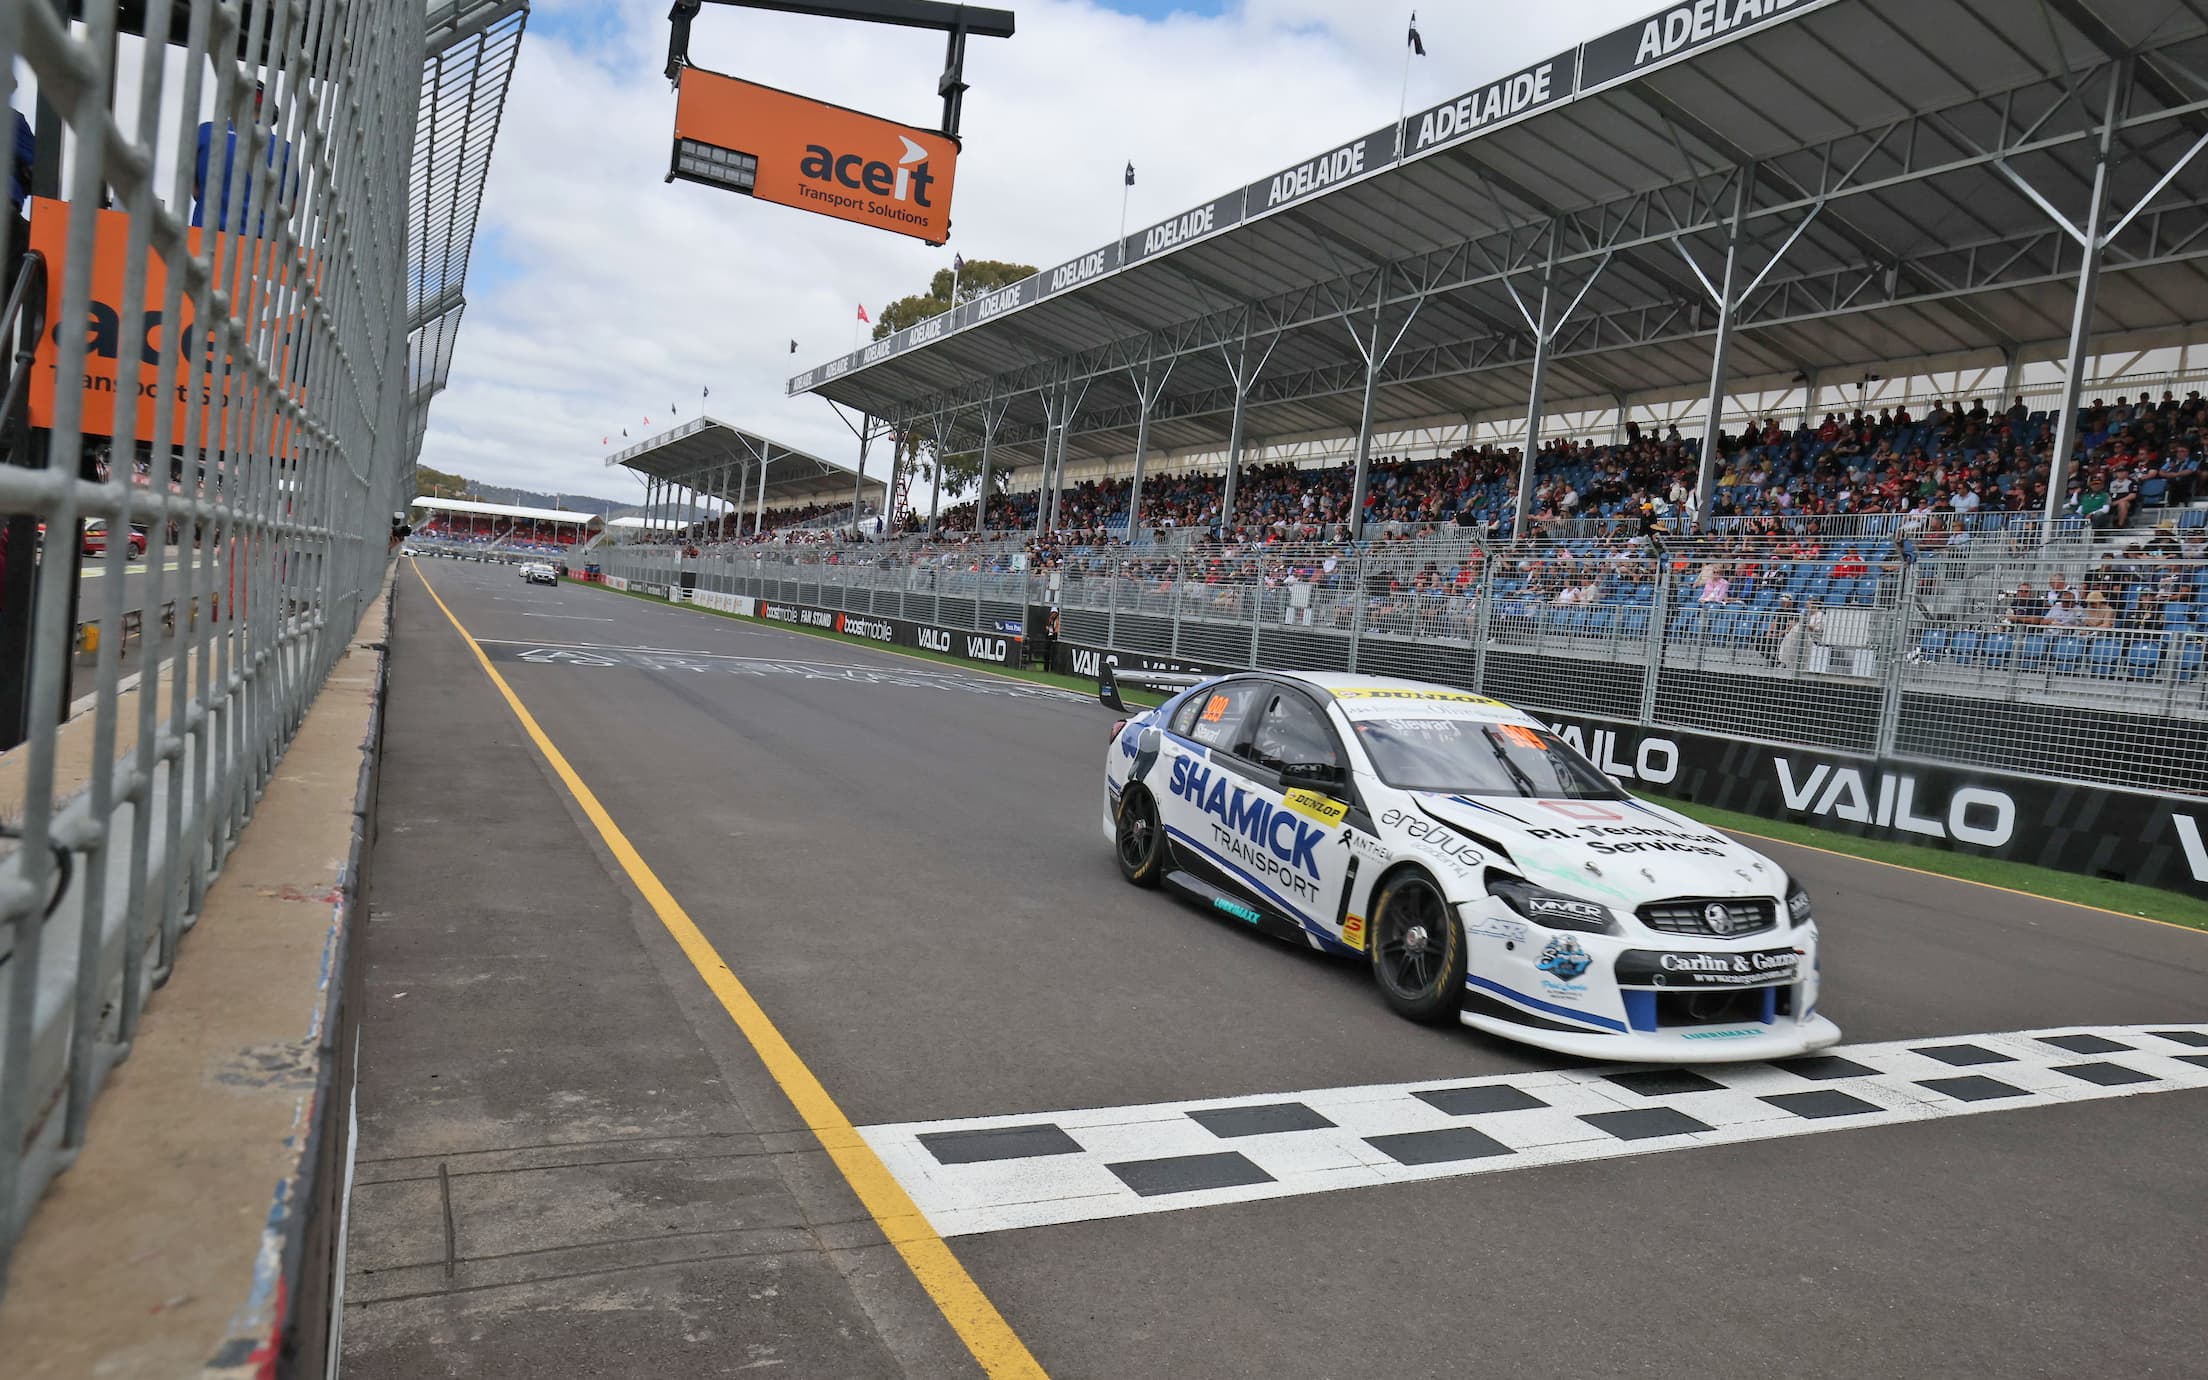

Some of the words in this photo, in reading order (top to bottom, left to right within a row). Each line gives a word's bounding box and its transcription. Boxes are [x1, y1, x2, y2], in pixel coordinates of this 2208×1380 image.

[1634, 0, 1796, 65] ADELA
[1416, 62, 1553, 149] ADELAIDE
[799, 135, 935, 207] aceit
[1268, 140, 1366, 206] ADELAIDE
[798, 183, 864, 210] Transport
[867, 201, 929, 227] Solutions
[1144, 204, 1215, 255] ADELAIDE
[1051, 250, 1104, 292] ADELAIDE
[978, 285, 1021, 320] ADELAIDE
[909, 318, 942, 347] ADELAIDE
[863, 340, 891, 364] ADELAIDE
[825, 357, 849, 379] ADELAIDE
[800, 609, 812, 624] FAN
[812, 611, 832, 627] STAND
[844, 613, 893, 642] boostmobile
[917, 626, 950, 653] VAILO
[966, 635, 1007, 662] VAILO
[1370, 691, 1492, 704] DUNLOP
[1387, 719, 1458, 732] Stewart
[1295, 794, 1341, 817] DUNLOP
[1774, 757, 2016, 848] VAILO
[1170, 755, 1326, 880] SHAMICK
[1381, 809, 1484, 866] erebus
[1526, 828, 1581, 840] P.I.
[1577, 825, 1727, 845] Technical
[1586, 840, 1726, 857] Services
[1211, 823, 1319, 903] TRANSPORT
[1660, 954, 1729, 971] Carlin
[1733, 955, 1751, 972] &
